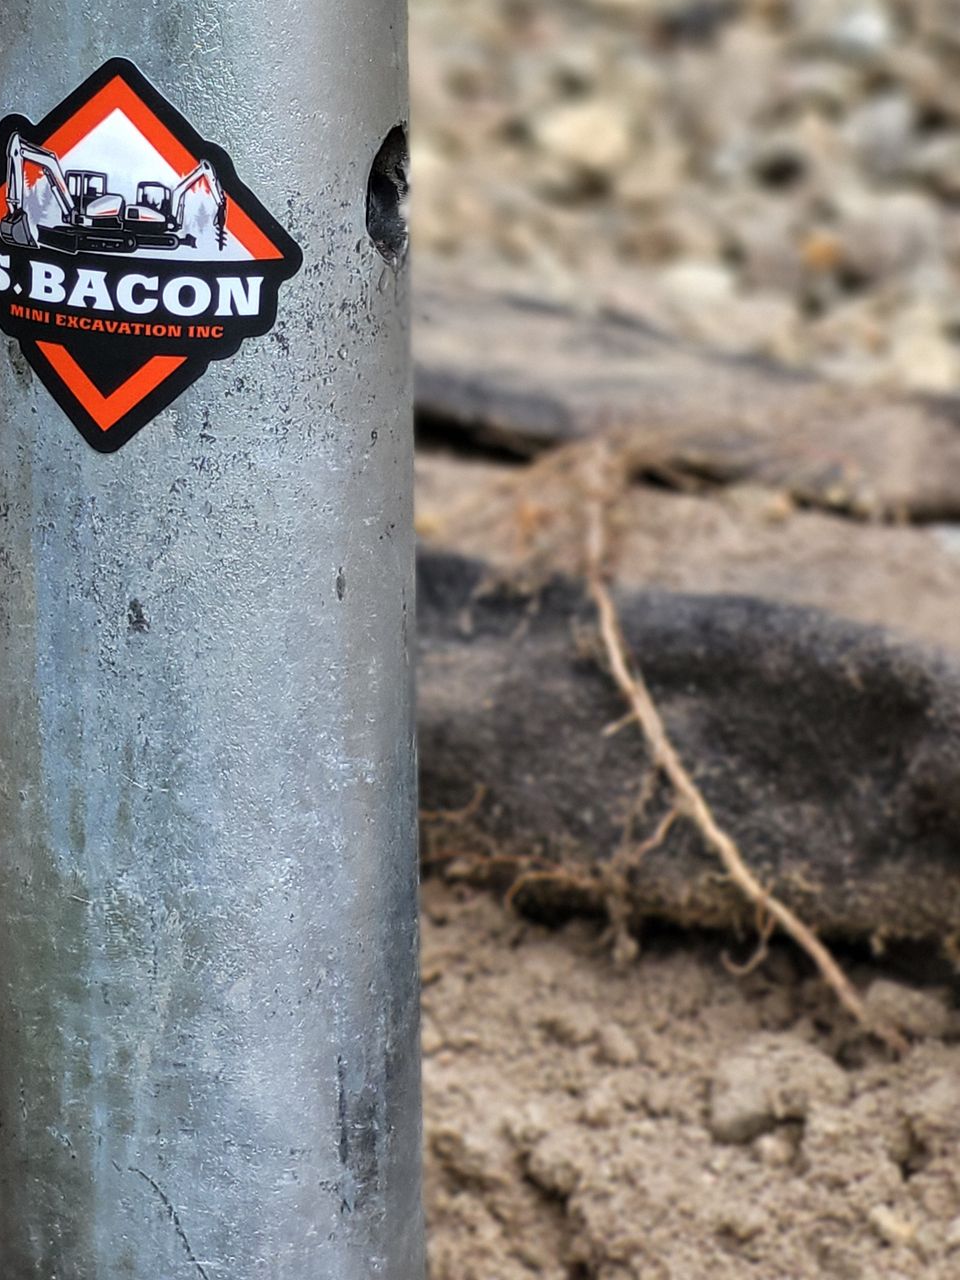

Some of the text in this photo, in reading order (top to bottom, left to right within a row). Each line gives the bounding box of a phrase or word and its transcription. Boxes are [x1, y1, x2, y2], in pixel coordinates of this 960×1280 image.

[10, 304, 224, 339] MINI EXCAVATION INC
